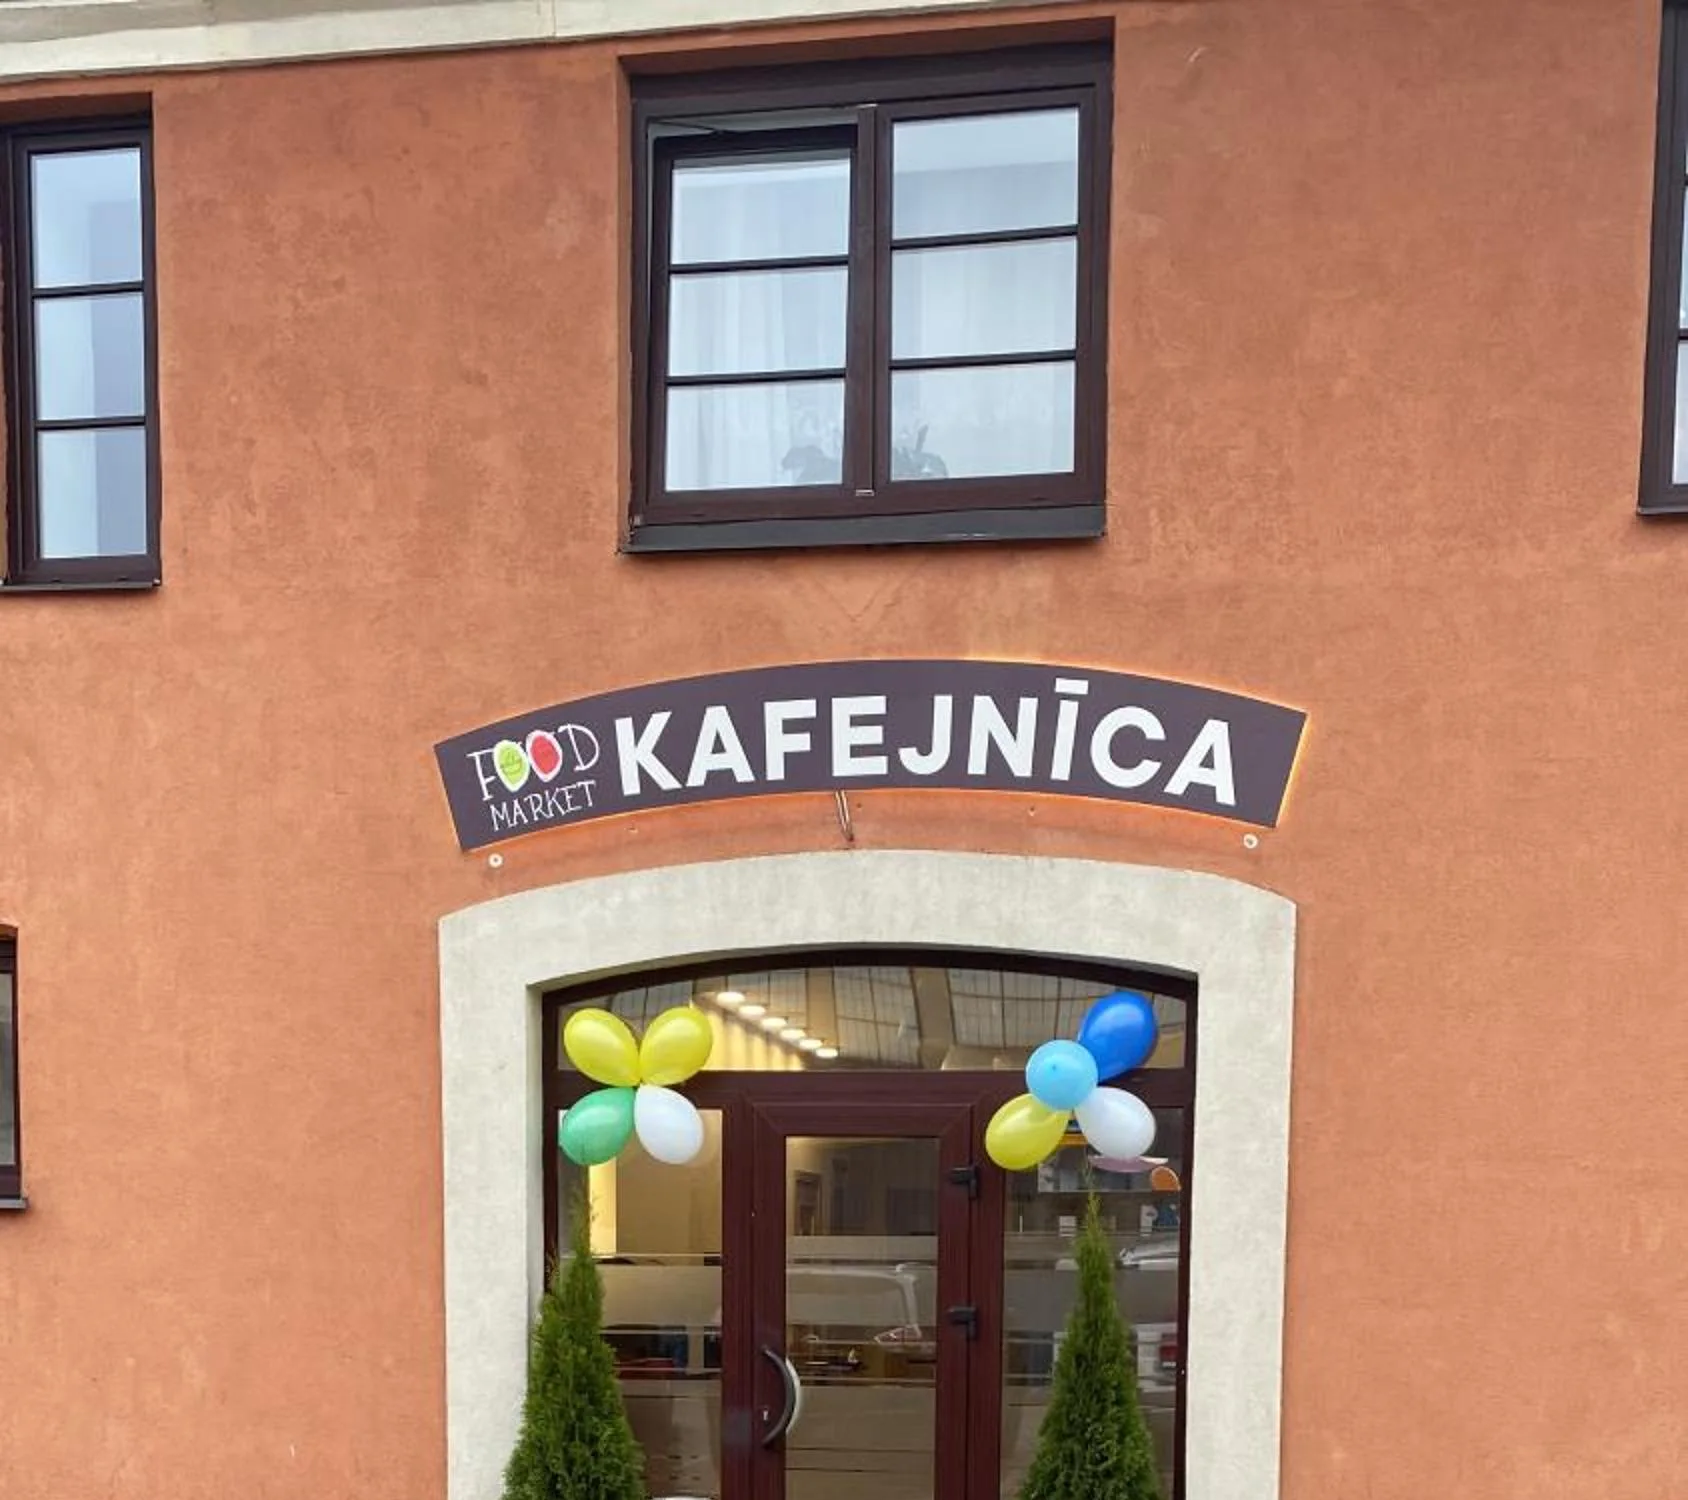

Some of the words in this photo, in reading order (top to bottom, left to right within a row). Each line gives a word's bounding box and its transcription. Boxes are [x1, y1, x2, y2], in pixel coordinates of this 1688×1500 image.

[467, 723, 599, 801] FOOD
[614, 677, 1236, 806] KAFEJNĪCA
[490, 780, 597, 832] MARKET
